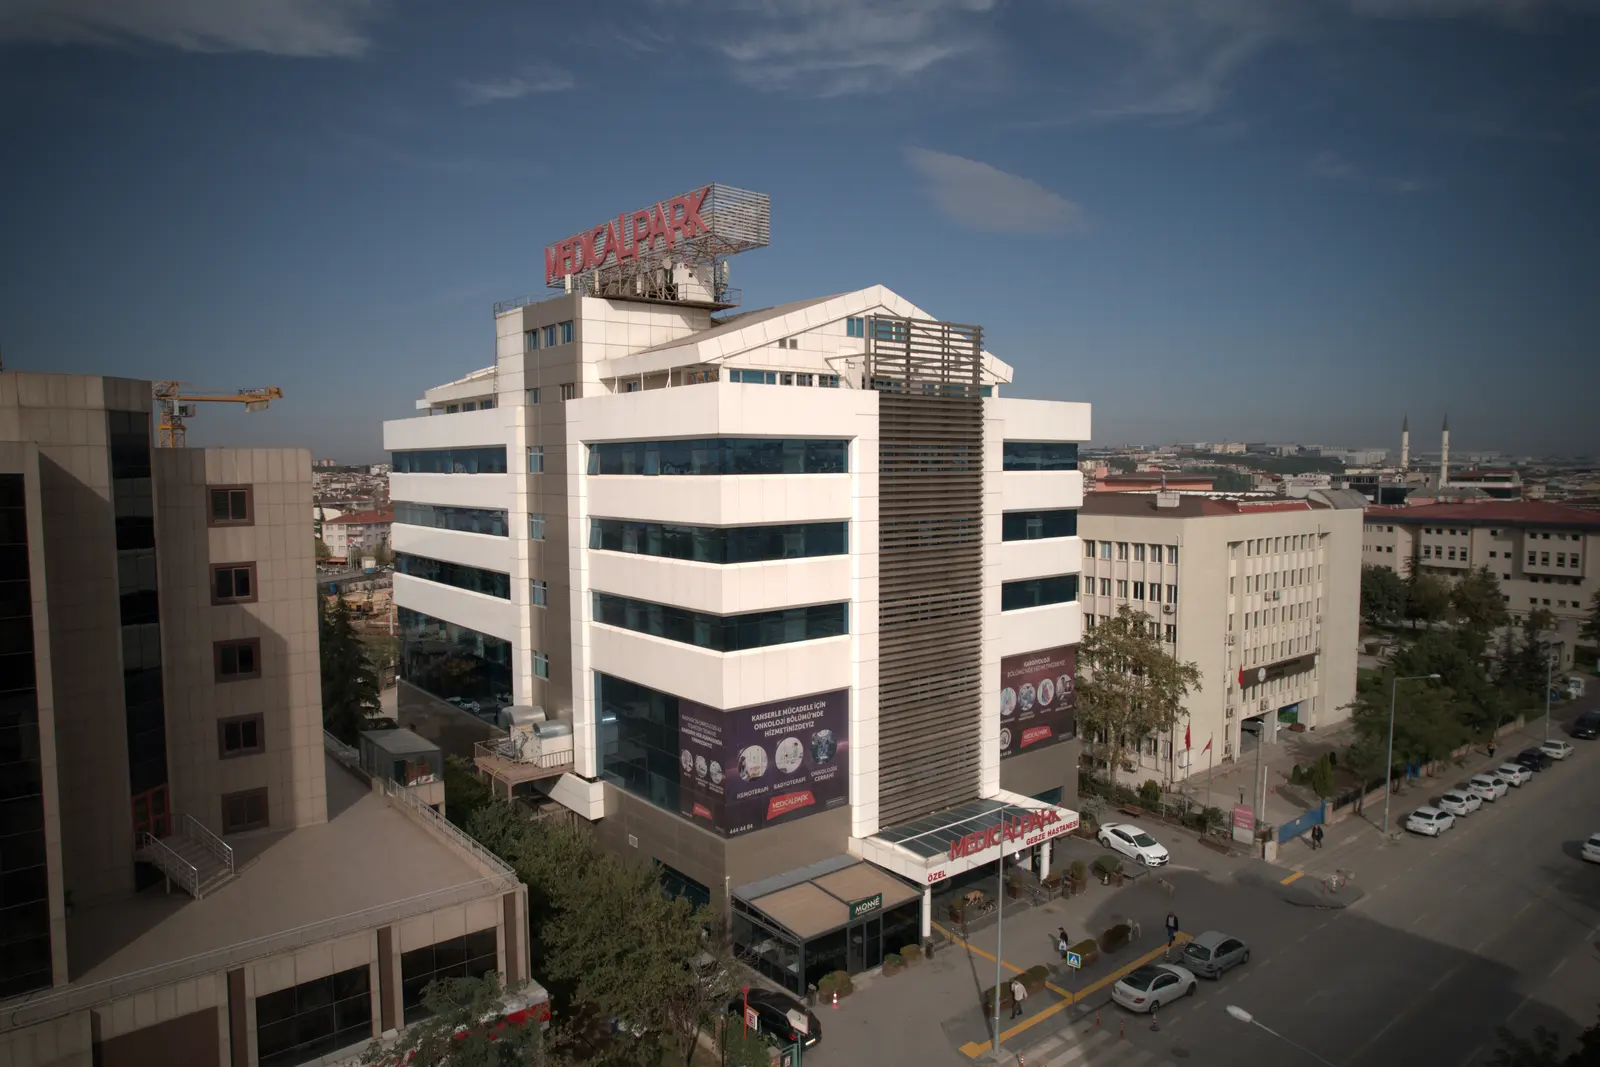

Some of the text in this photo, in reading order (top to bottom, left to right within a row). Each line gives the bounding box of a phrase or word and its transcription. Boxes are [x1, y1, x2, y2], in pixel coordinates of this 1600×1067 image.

[545, 186, 711, 284] MEDICALPARK
[751, 700, 826, 722] KANSERLE MÜCADELE İÇİN
[753, 710, 824, 731] ONKOLOJİ BÖLÜMÜ'NDE
[764, 721, 815, 738] HİZMETİNİZDEYİZ
[927, 818, 1079, 883] ÖZEL GEBZE HASTANESİ
[949, 802, 1062, 861] MEDICALPARK
